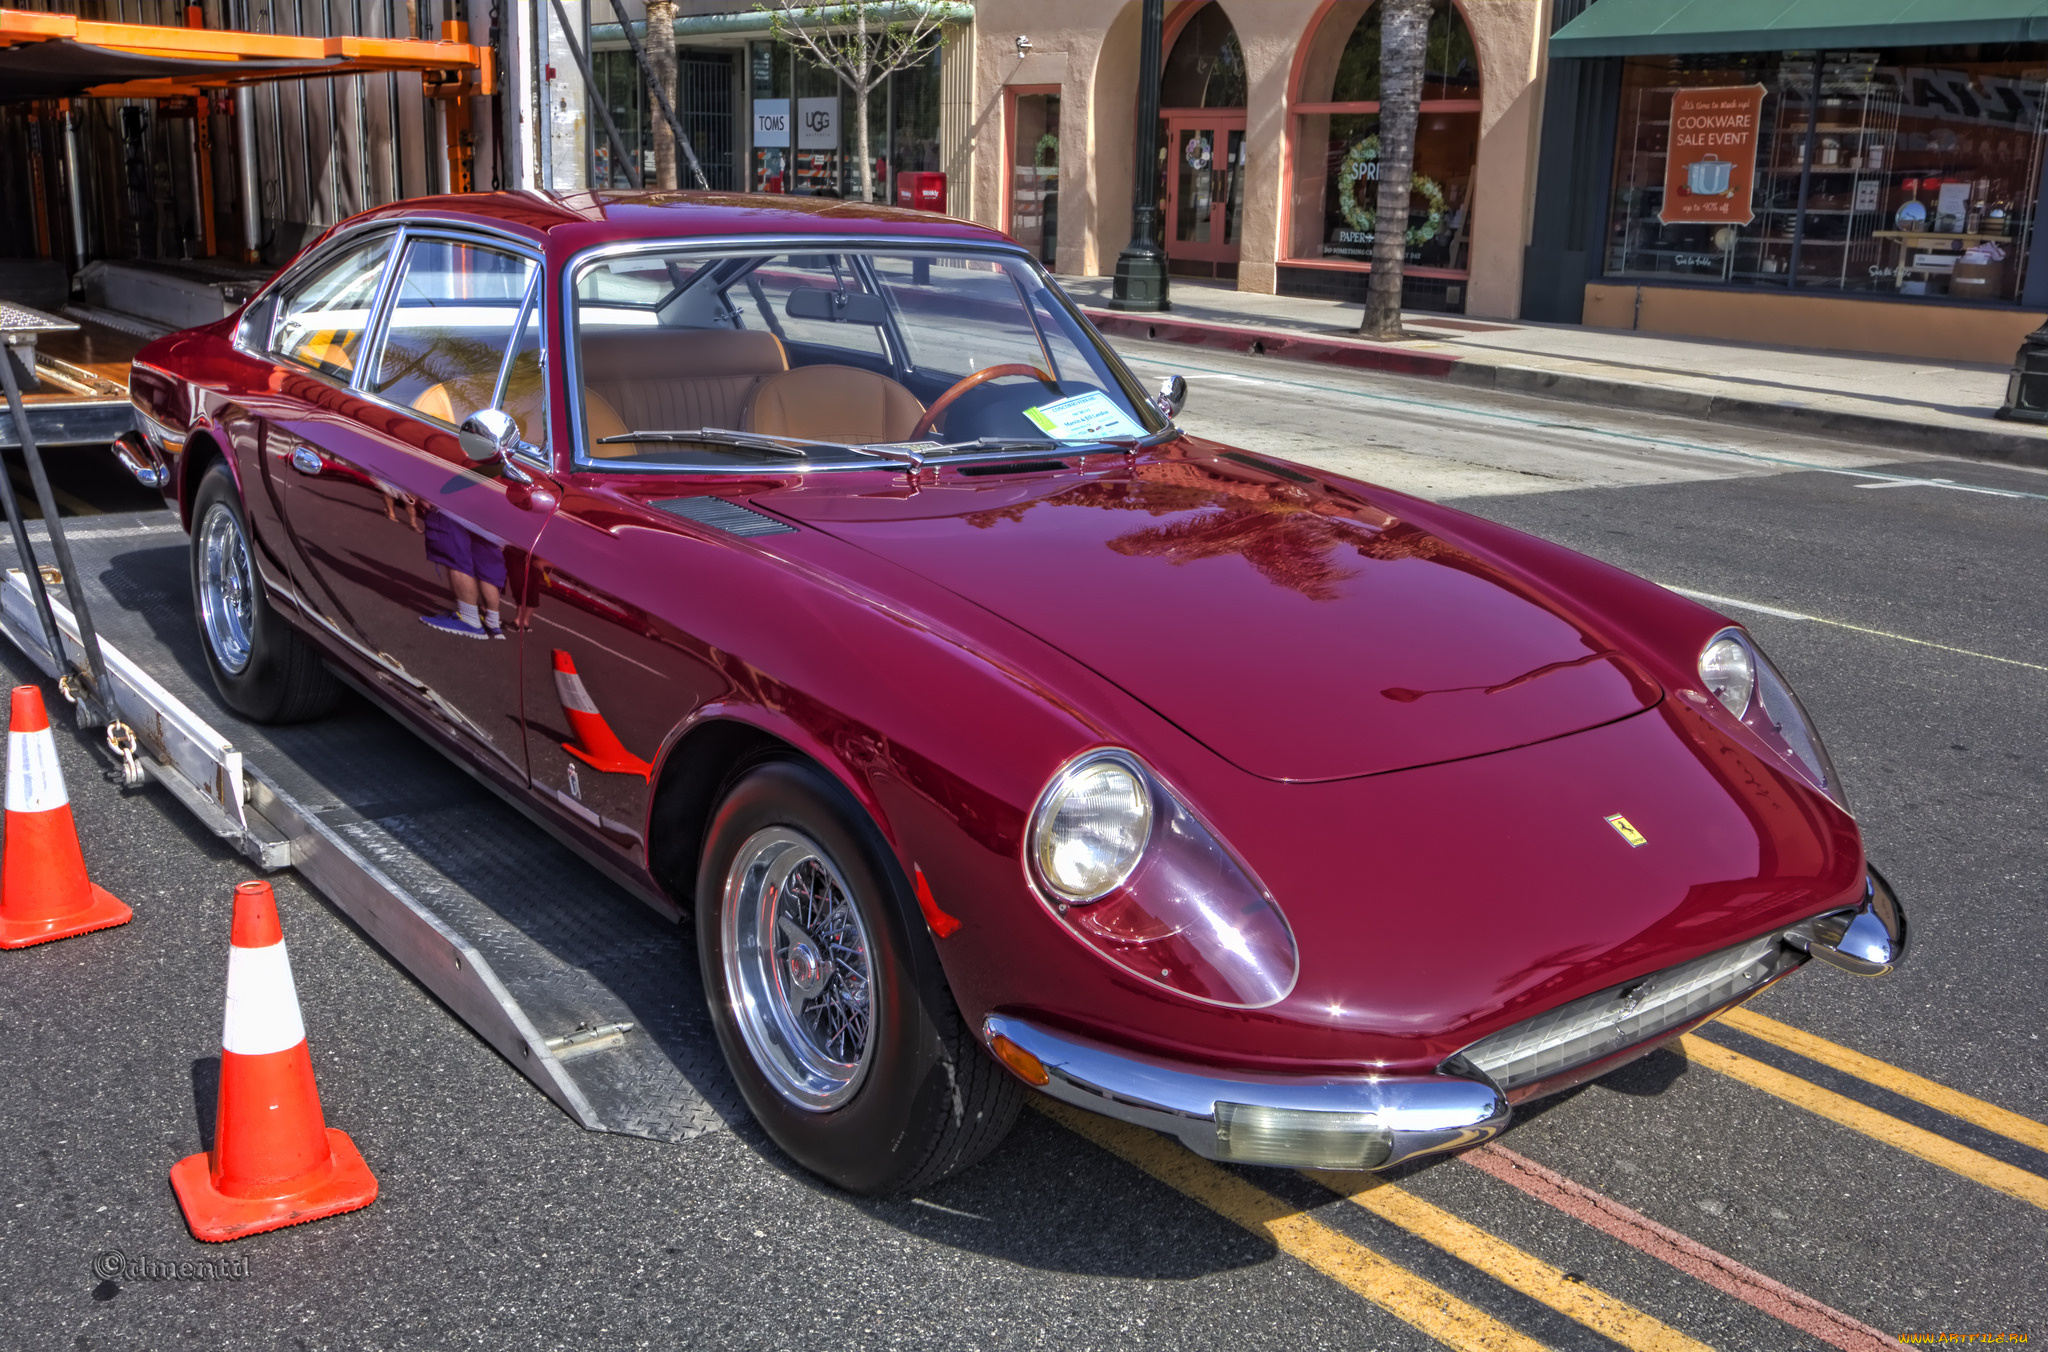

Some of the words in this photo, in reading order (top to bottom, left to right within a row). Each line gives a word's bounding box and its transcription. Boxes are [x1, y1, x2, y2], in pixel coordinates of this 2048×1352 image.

[1711, 101, 1719, 109] to
[758, 115, 785, 131] TOMS
[805, 110, 830, 132] UGG
[1677, 115, 1752, 129] COOKWARE
[1676, 133, 1706, 146] SALE
[1707, 132, 1750, 145] EVENT
[1351, 162, 1380, 181] SPRI
[1340, 231, 1366, 242] PAPER
